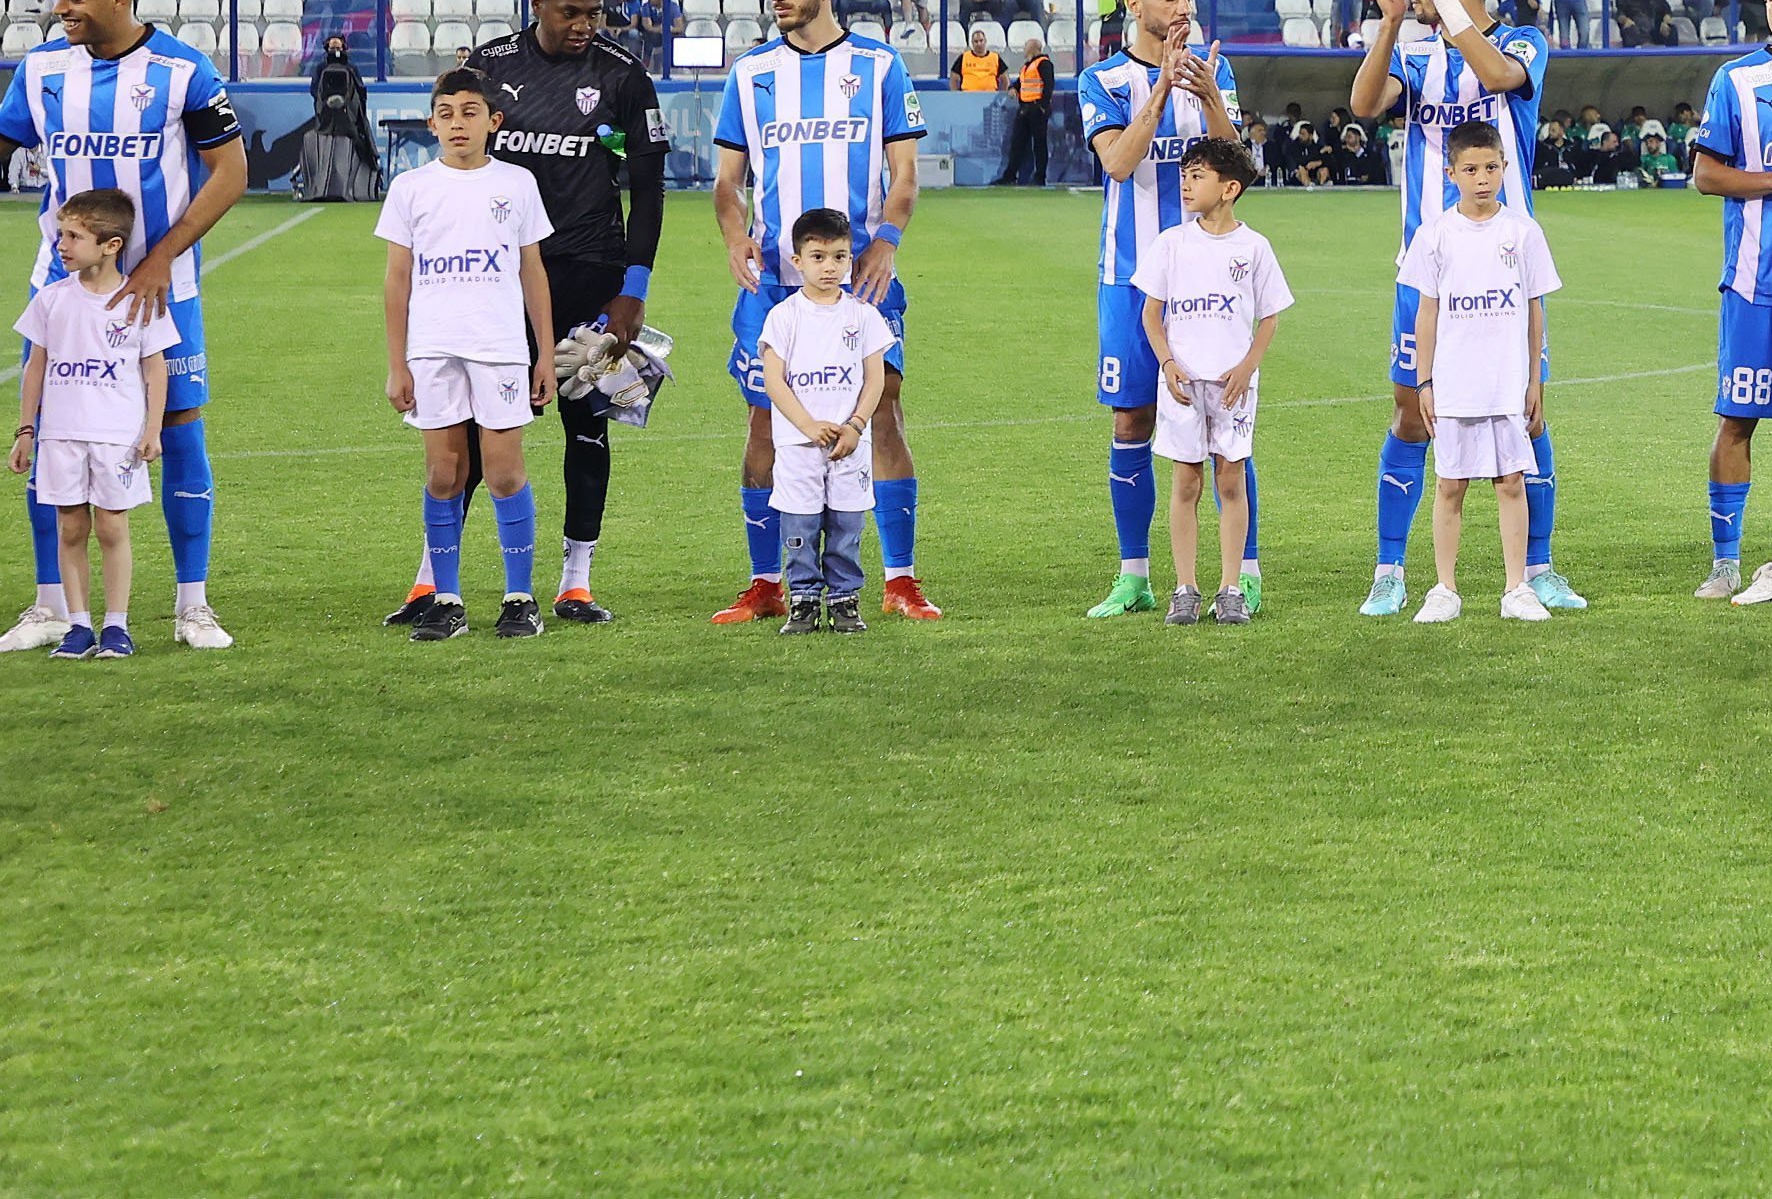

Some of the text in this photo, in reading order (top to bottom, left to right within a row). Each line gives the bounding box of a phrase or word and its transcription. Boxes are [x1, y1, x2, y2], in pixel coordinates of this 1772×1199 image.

[481, 42, 518, 57] cyprus
[494, 131, 594, 157] FONBET
[764, 120, 865, 145] FONBET
[52, 134, 158, 158] FONBET
[419, 249, 501, 276] IronFX
[419, 278, 446, 286] SOLID
[1449, 288, 1515, 311] IronFX
[49, 358, 117, 383] ronFX
[1101, 356, 1121, 394] 8
[1732, 367, 1772, 404] 88
